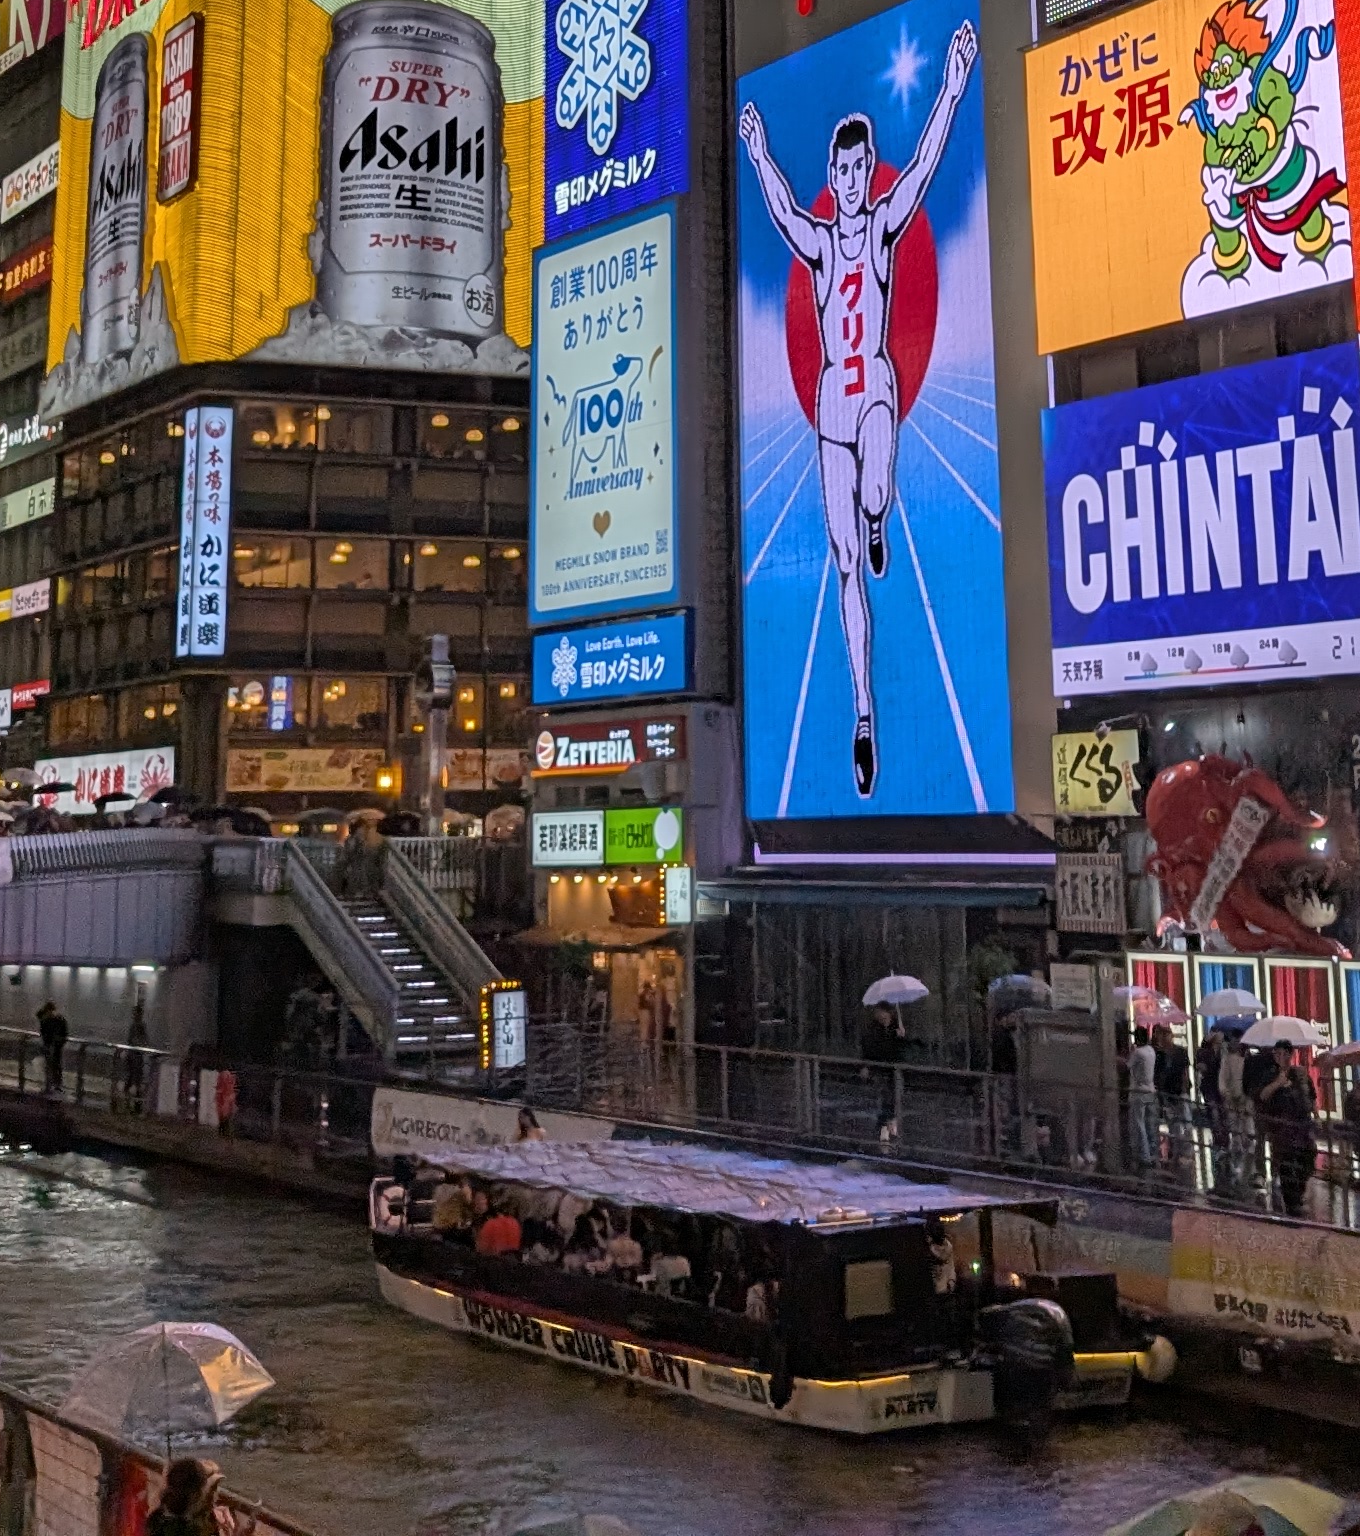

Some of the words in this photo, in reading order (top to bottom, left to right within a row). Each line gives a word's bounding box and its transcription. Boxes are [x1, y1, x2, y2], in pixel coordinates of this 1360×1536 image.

[163, 31, 195, 87] ASAHI
[390, 60, 444, 78] SUPER
[1058, 31, 1159, 98] かぜに
[161, 90, 192, 146] 1889
[339, 106, 485, 184] Asahi
[1050, 68, 1175, 177] 改源
[159, 137, 191, 194] OSAKA
[554, 148, 658, 216] 雪印メグミルク
[394, 184, 432, 212] 生
[369, 233, 458, 254] スーパードライ
[550, 241, 659, 310] 創業100周年
[563, 296, 644, 351] ありがとう
[839, 262, 866, 398] グリコ
[203, 445, 224, 525] 本場の味
[563, 466, 644, 501] Anniversary
[593, 548, 618, 565] SNOW
[620, 542, 650, 560] BRAND
[197, 534, 222, 646] かに道楽
[580, 652, 666, 690] 雪印メグミルク
[556, 736, 636, 768] ZETTERIA
